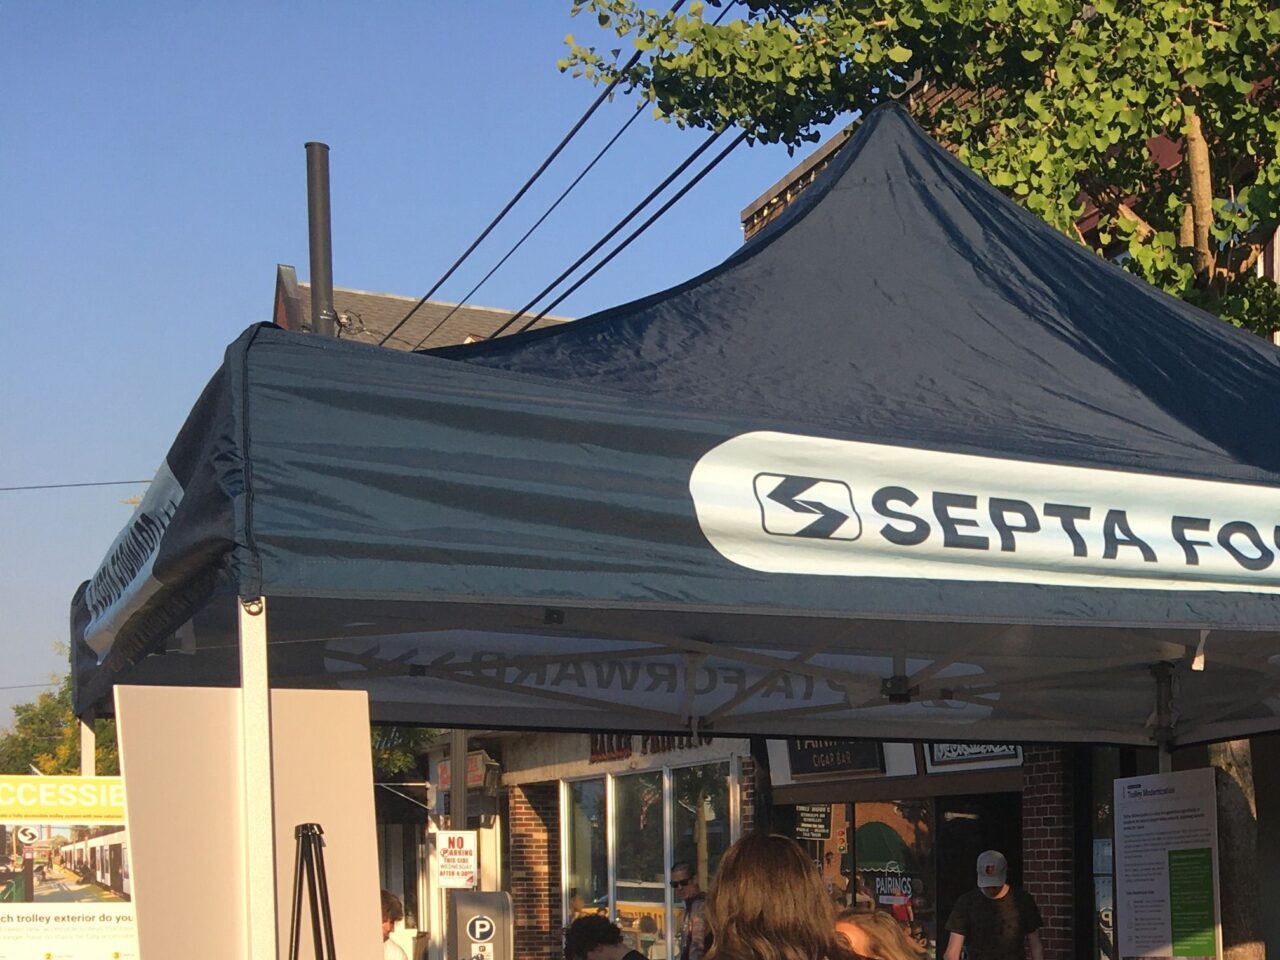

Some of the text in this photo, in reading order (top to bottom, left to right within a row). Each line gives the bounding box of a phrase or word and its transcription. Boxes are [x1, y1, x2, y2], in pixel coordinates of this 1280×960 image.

[872, 486, 1158, 562] SEPTA
[812, 752, 834, 767] CIGAR
[448, 836, 464, 849] NO
[876, 877, 912, 894] PAIRINGS
[17, 914, 51, 924] trolley
[54, 914, 96, 923] exterior
[99, 913, 112, 923] do
[116, 915, 133, 924] you
[475, 920, 489, 939] P
